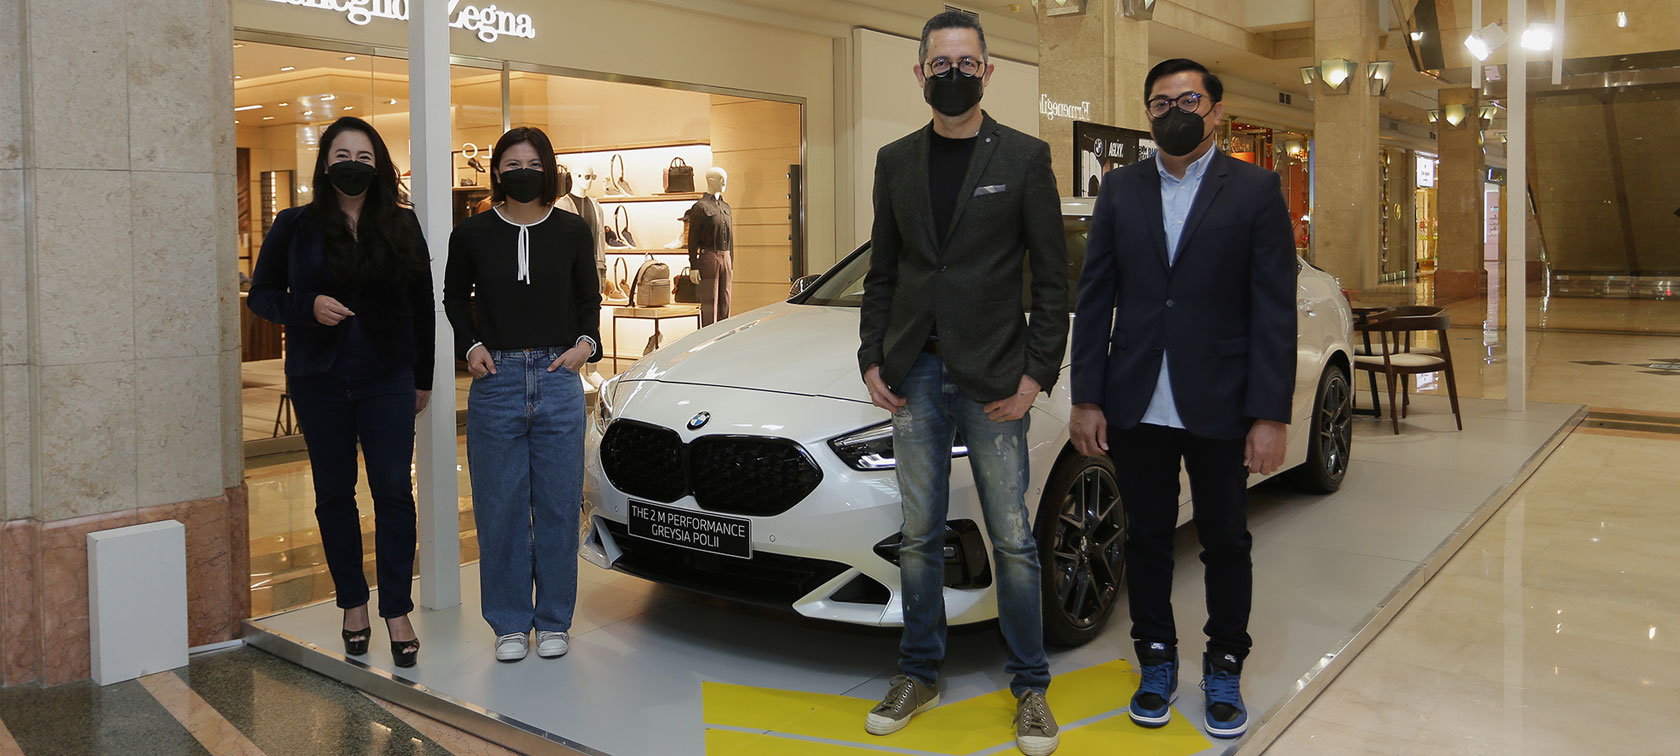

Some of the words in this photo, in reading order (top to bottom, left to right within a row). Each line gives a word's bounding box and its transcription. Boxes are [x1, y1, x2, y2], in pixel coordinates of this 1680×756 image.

[631, 505, 649, 520] THE
[650, 509, 656, 522] 2
[657, 511, 666, 524] M
[667, 513, 746, 538] PERFORMANCE
[651, 523, 691, 543] GREYSIA
[693, 532, 720, 548] POLII
